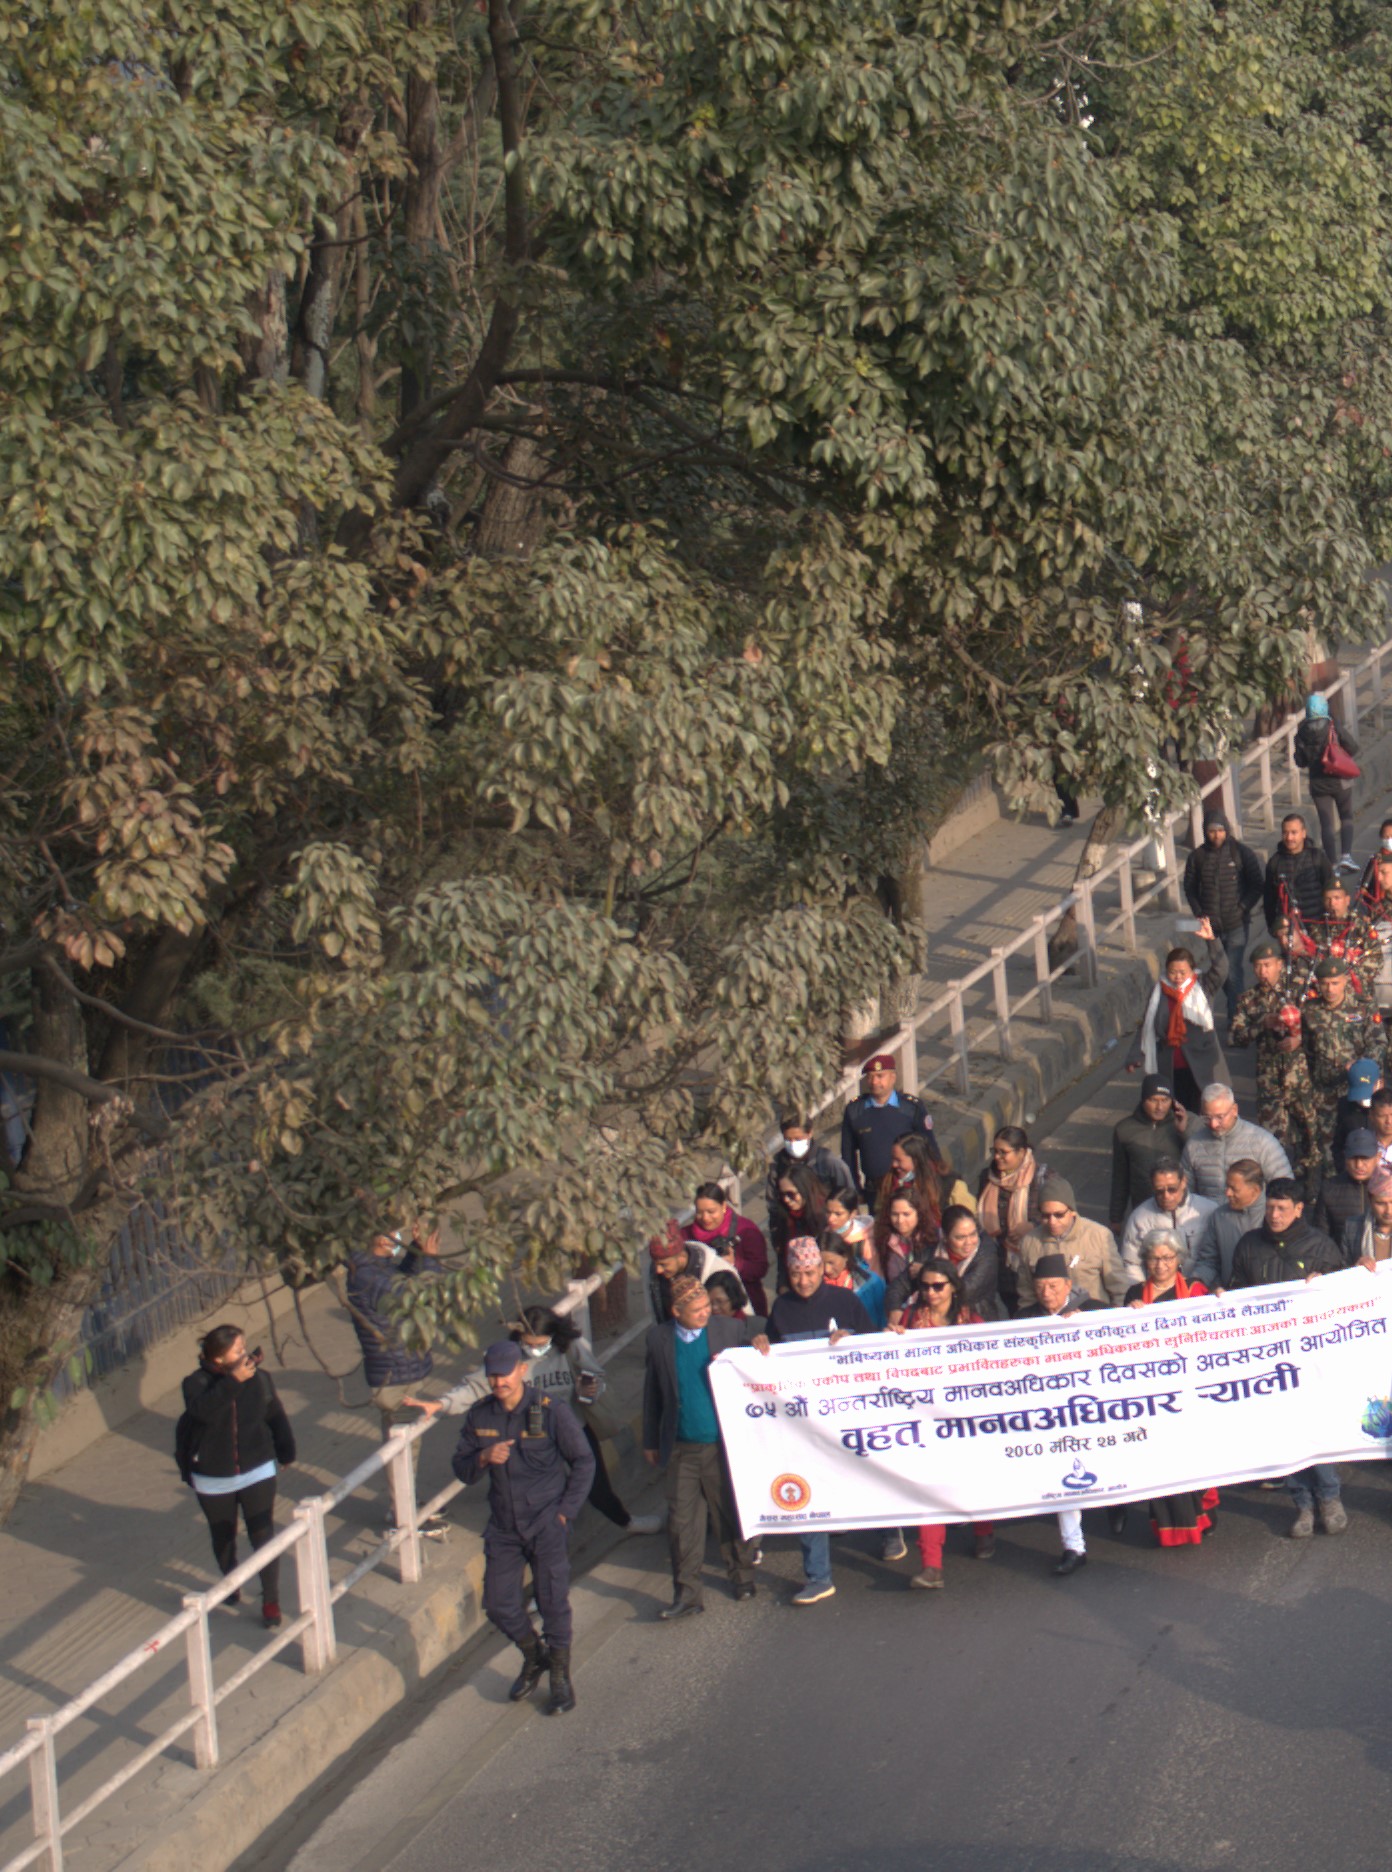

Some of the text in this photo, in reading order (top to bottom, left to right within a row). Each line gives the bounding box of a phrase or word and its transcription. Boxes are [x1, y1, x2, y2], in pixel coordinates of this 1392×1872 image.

[745, 1402, 777, 1419] ७५
[818, 1386, 936, 1416] अन्तर्राष्ट्रिय
[943, 1369, 1092, 1403] मानवअधिकार
[1100, 1352, 1188, 1384] दिवसको
[1196, 1338, 1292, 1372] अवसरमा
[1300, 1317, 1388, 1352] आयोजित
[904, 1345, 941, 1359] मानव
[946, 1339, 1000, 1354] अधिकार
[840, 1420, 927, 1457] वृहत्
[933, 1390, 1183, 1440] मानवअधिकार
[1004, 1442, 1043, 1459] २०८०
[1096, 1434, 1117, 1448] २४
[1122, 1425, 1148, 1444] गते
